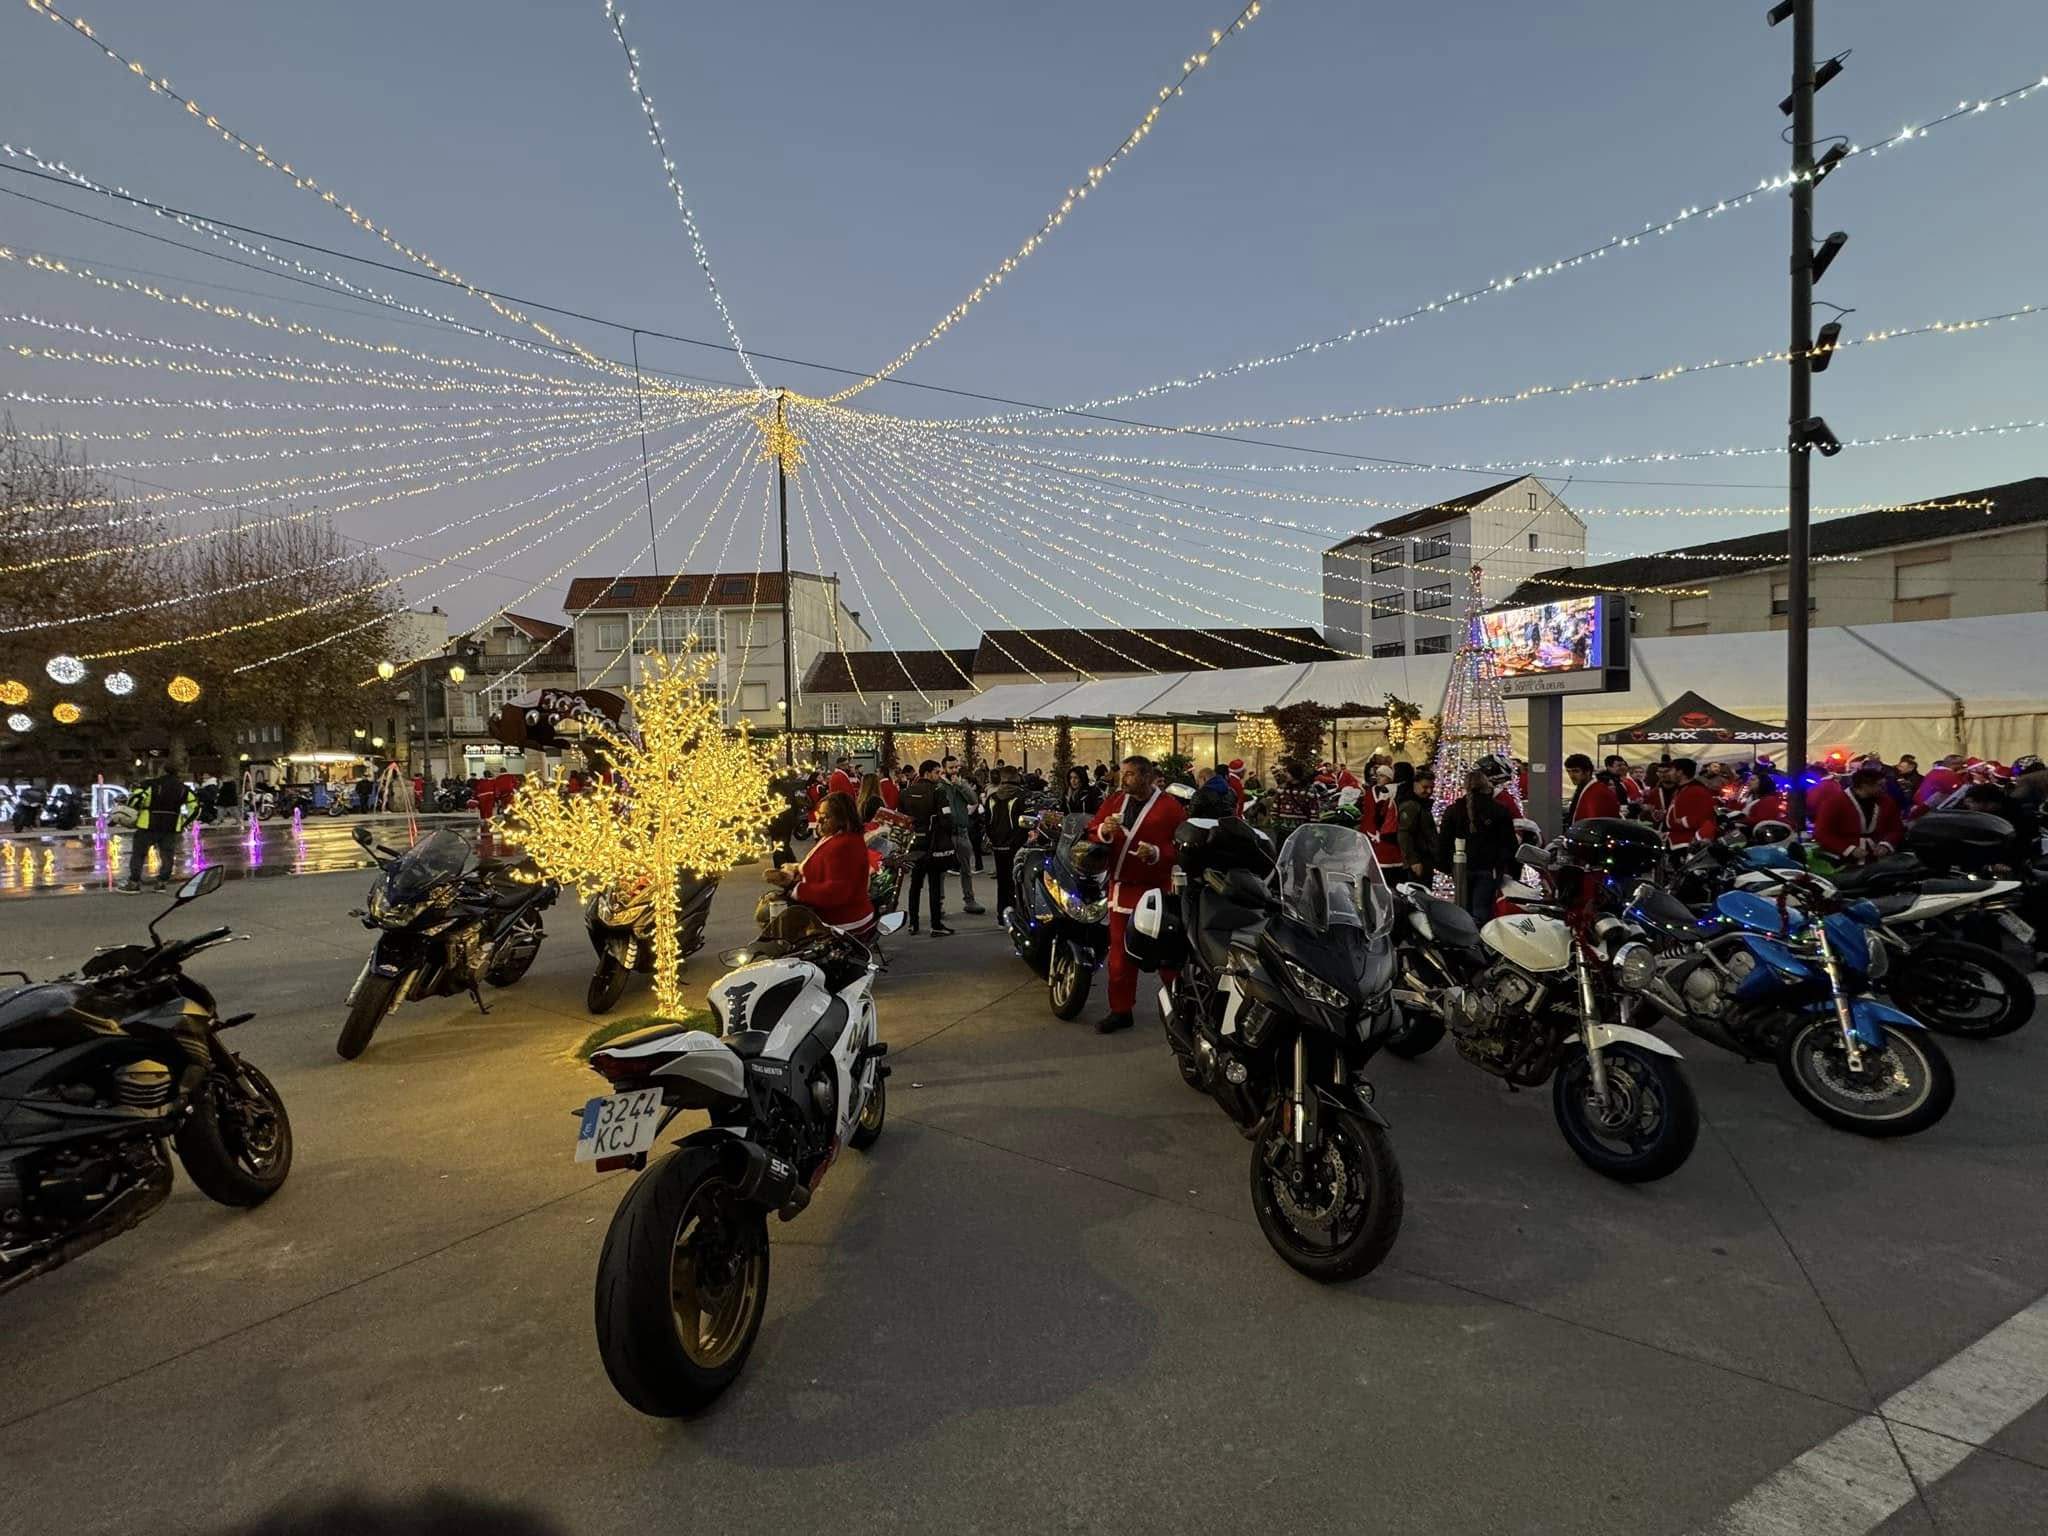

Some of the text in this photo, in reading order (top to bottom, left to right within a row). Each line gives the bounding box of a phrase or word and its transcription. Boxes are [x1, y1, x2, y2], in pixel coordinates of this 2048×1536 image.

[1647, 731, 1699, 741] 24MX
[1734, 731, 1788, 741] 24MX
[601, 1093, 656, 1124] 3244
[594, 1122, 639, 1154] KCJ
[770, 1158, 789, 1177] SC
